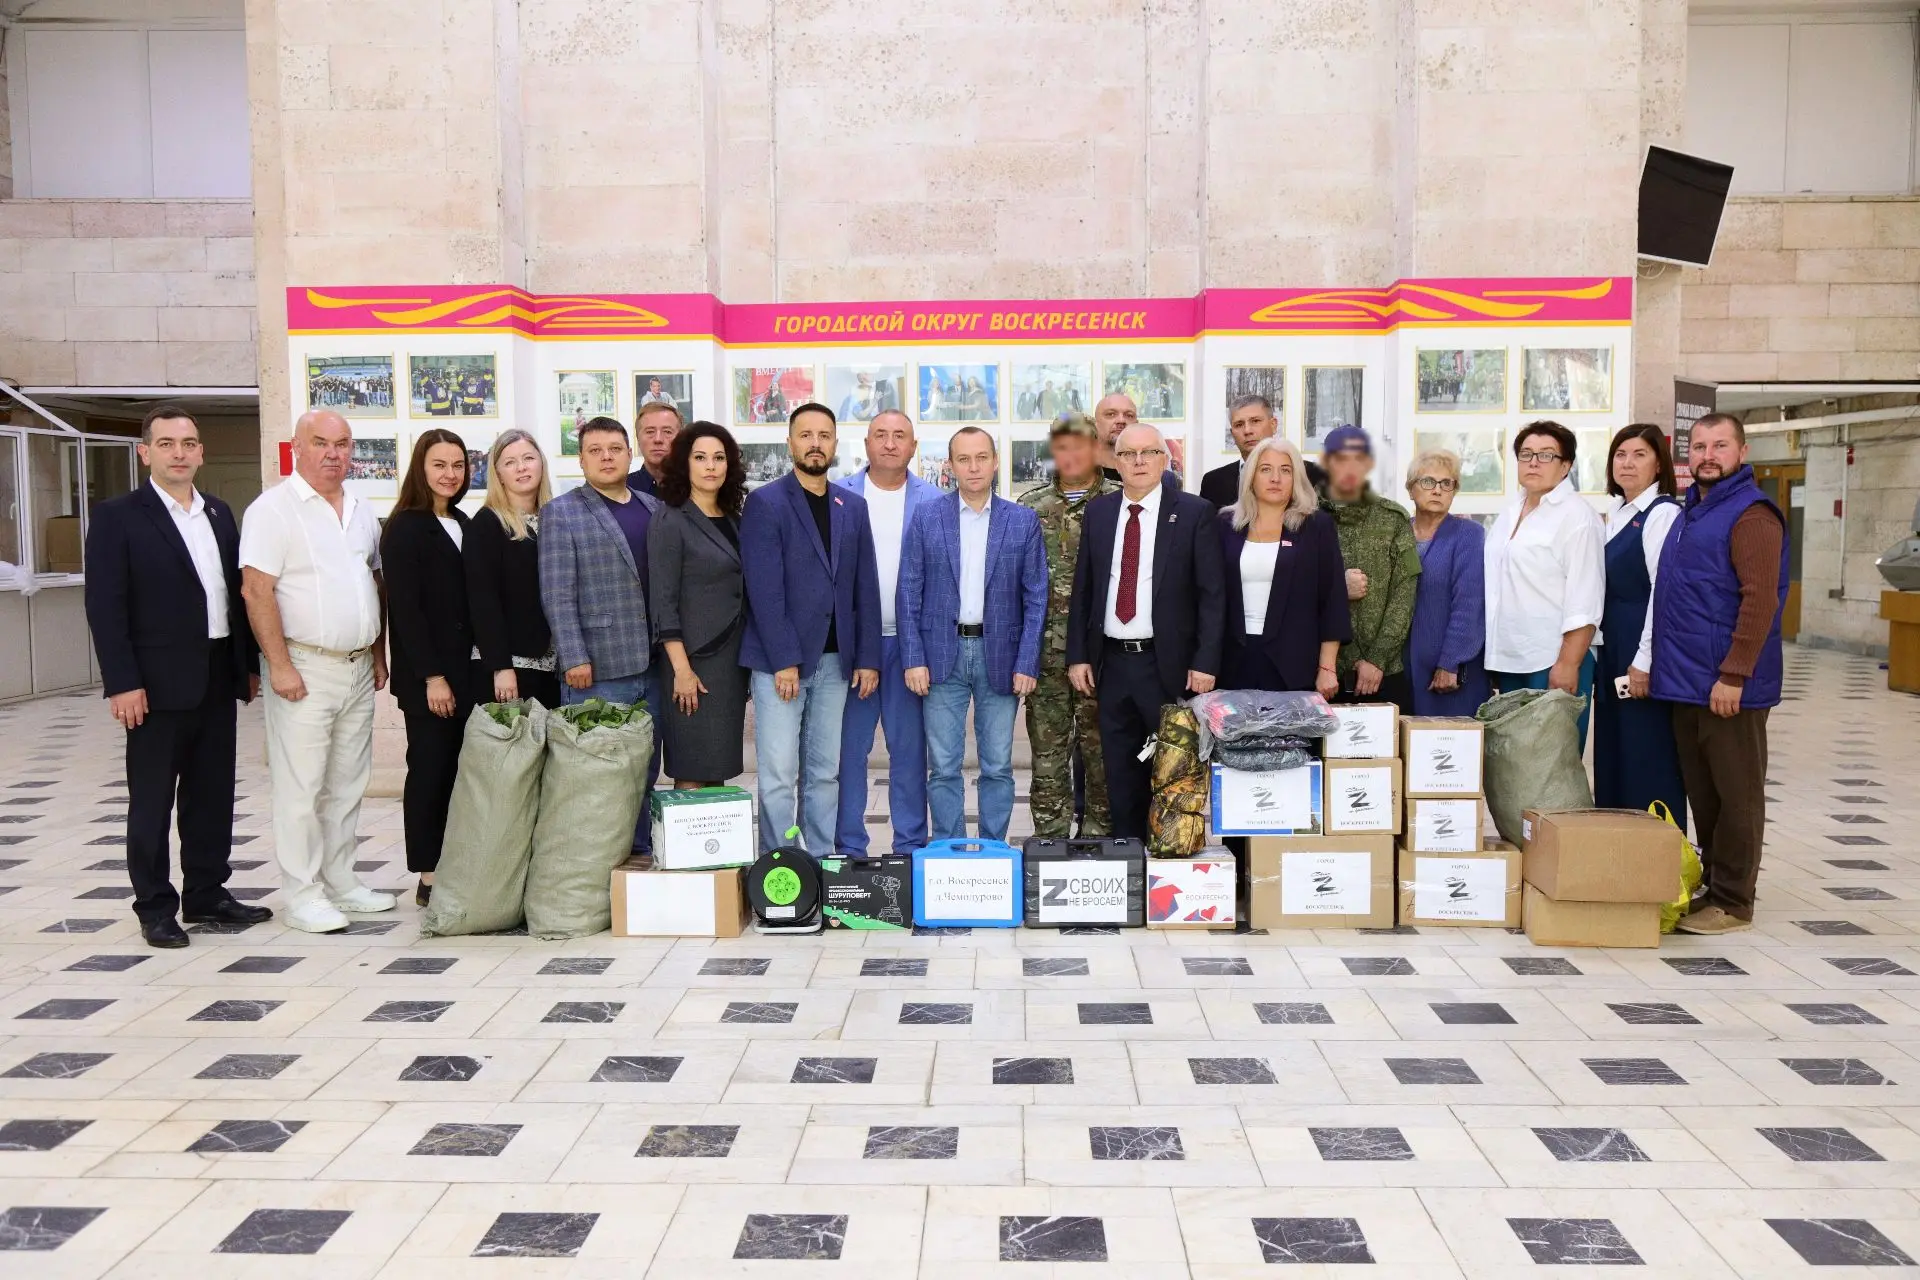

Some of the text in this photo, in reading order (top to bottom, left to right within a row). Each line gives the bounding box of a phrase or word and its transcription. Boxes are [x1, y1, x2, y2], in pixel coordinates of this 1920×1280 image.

[774, 310, 1147, 334] ГОРОДСКОЙ ОКРУГ ВОСКРЕСЕНСК
[948, 876, 1009, 888] Воскресенск
[1069, 877, 1126, 895] СВОИХ
[1042, 878, 1068, 907] Z
[1069, 896, 1081, 907] НЕ
